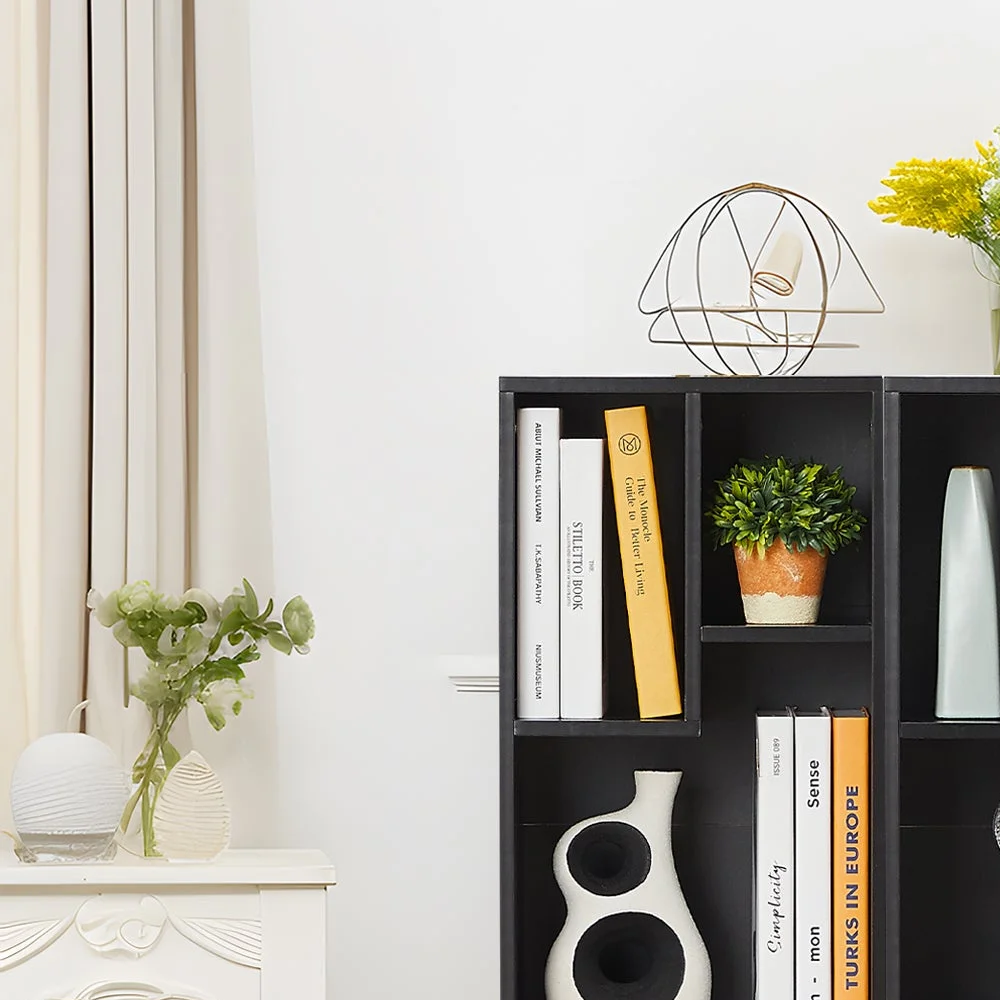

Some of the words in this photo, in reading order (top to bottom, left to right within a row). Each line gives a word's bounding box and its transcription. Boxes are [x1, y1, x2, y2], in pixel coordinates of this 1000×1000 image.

[534, 448, 542, 483] MICHAEL
[624, 476, 636, 508] Guide
[636, 478, 647, 497] The
[628, 510, 636, 521] to
[639, 499, 653, 543] Monocle
[572, 521, 584, 574] STILETTO
[630, 527, 641, 560] Better
[572, 579, 584, 611] BOOK
[634, 562, 646, 597] Living
[772, 737, 780, 752] 089
[807, 759, 820, 808] Sense
[845, 785, 859, 874] EUROPE
[766, 860, 787, 954] Simplicity
[845, 884, 859, 909] IN
[809, 925, 821, 962] mon
[845, 917, 859, 991] TURKS
